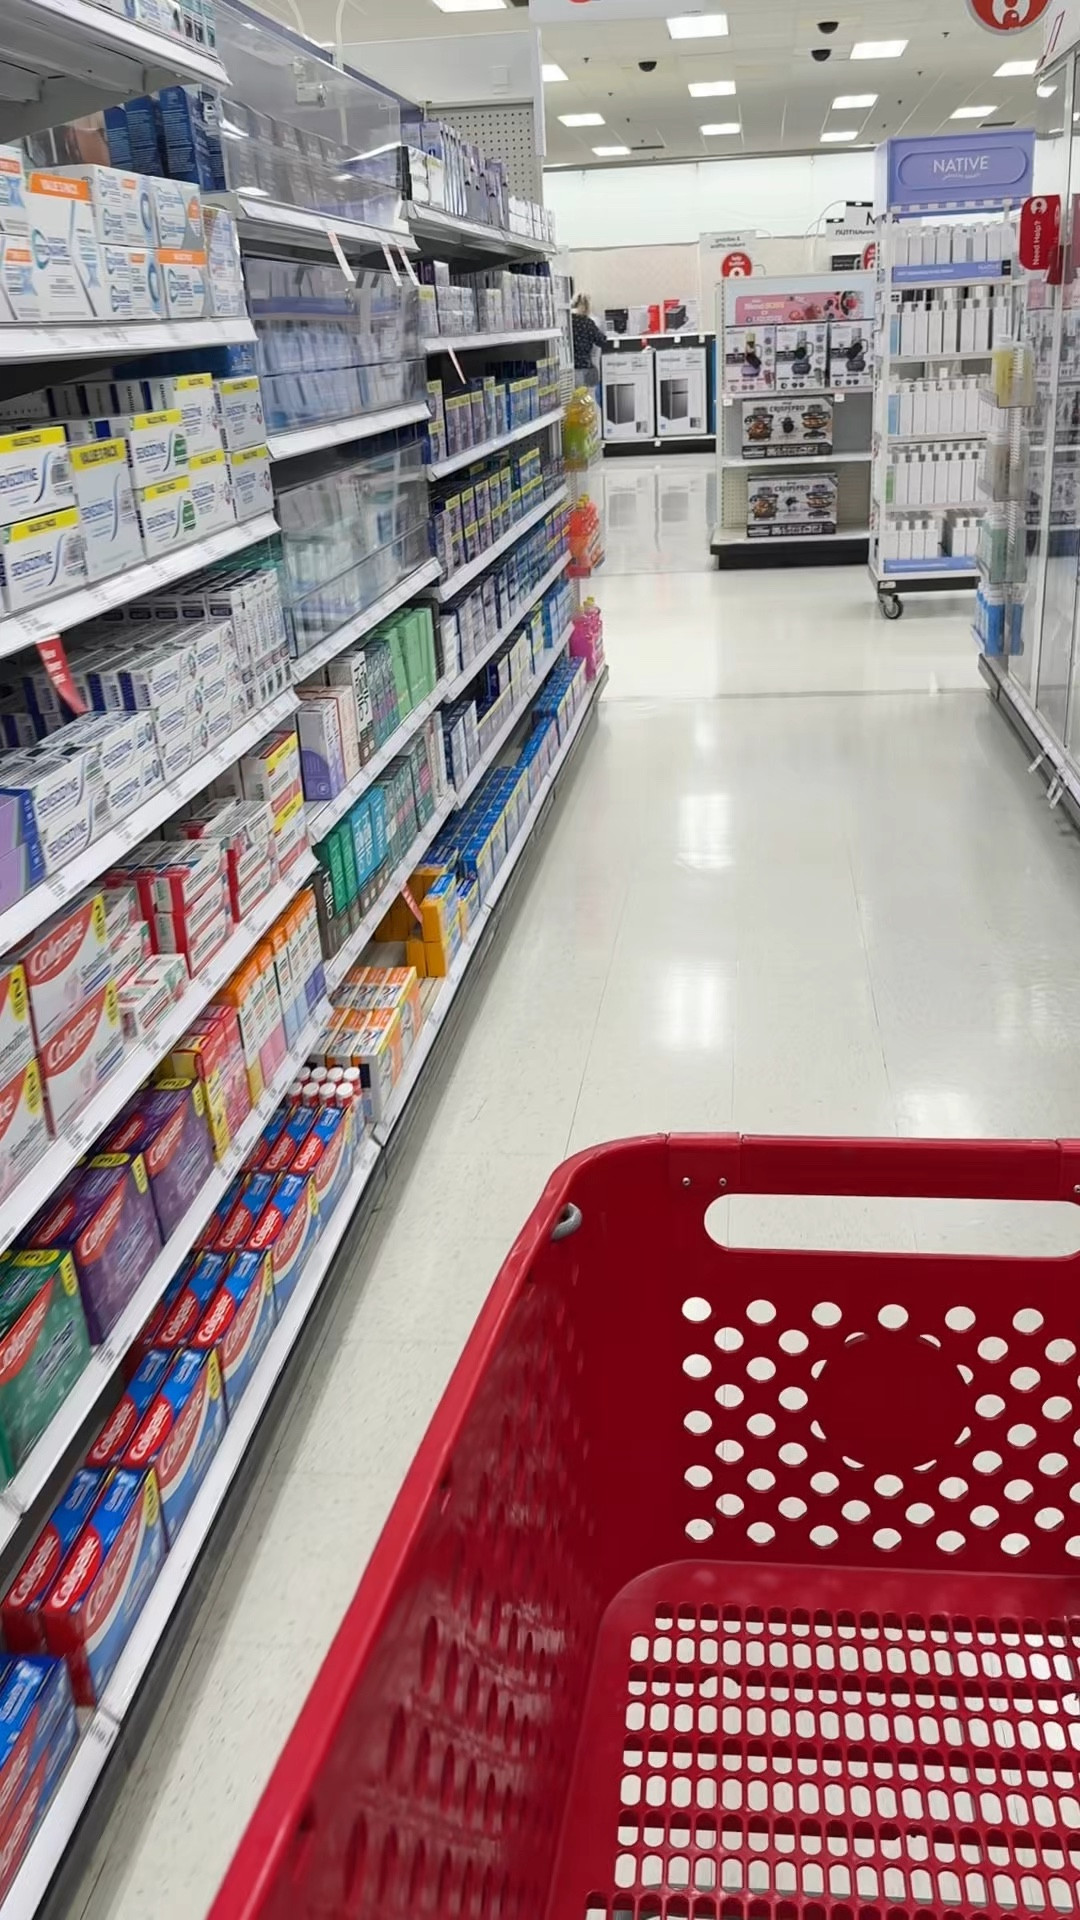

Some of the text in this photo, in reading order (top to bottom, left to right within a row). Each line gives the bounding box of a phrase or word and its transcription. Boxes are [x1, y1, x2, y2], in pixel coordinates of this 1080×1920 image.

[933, 155, 990, 173] NATIVE
[1032, 220, 1042, 265] Need Help?
[354, 660, 370, 722] hello
[322, 870, 334, 920] hello
[31, 920, 84, 978] Colgate
[48, 1007, 98, 1067] Colgate
[295, 1137, 319, 1169] Colgate
[81, 1195, 121, 1257] Colgate
[220, 1208, 249, 1247] Colgate
[251, 1210, 280, 1247] Colgate
[161, 1295, 196, 1342] Colgate
[199, 1294, 232, 1342] Colgate
[93, 1401, 135, 1459] Colgate
[130, 1402, 171, 1460] Colgate
[10, 1534, 59, 1606] Colgate
[51, 1535, 99, 1608] Colgate
[86, 1517, 138, 1627] Colgate
